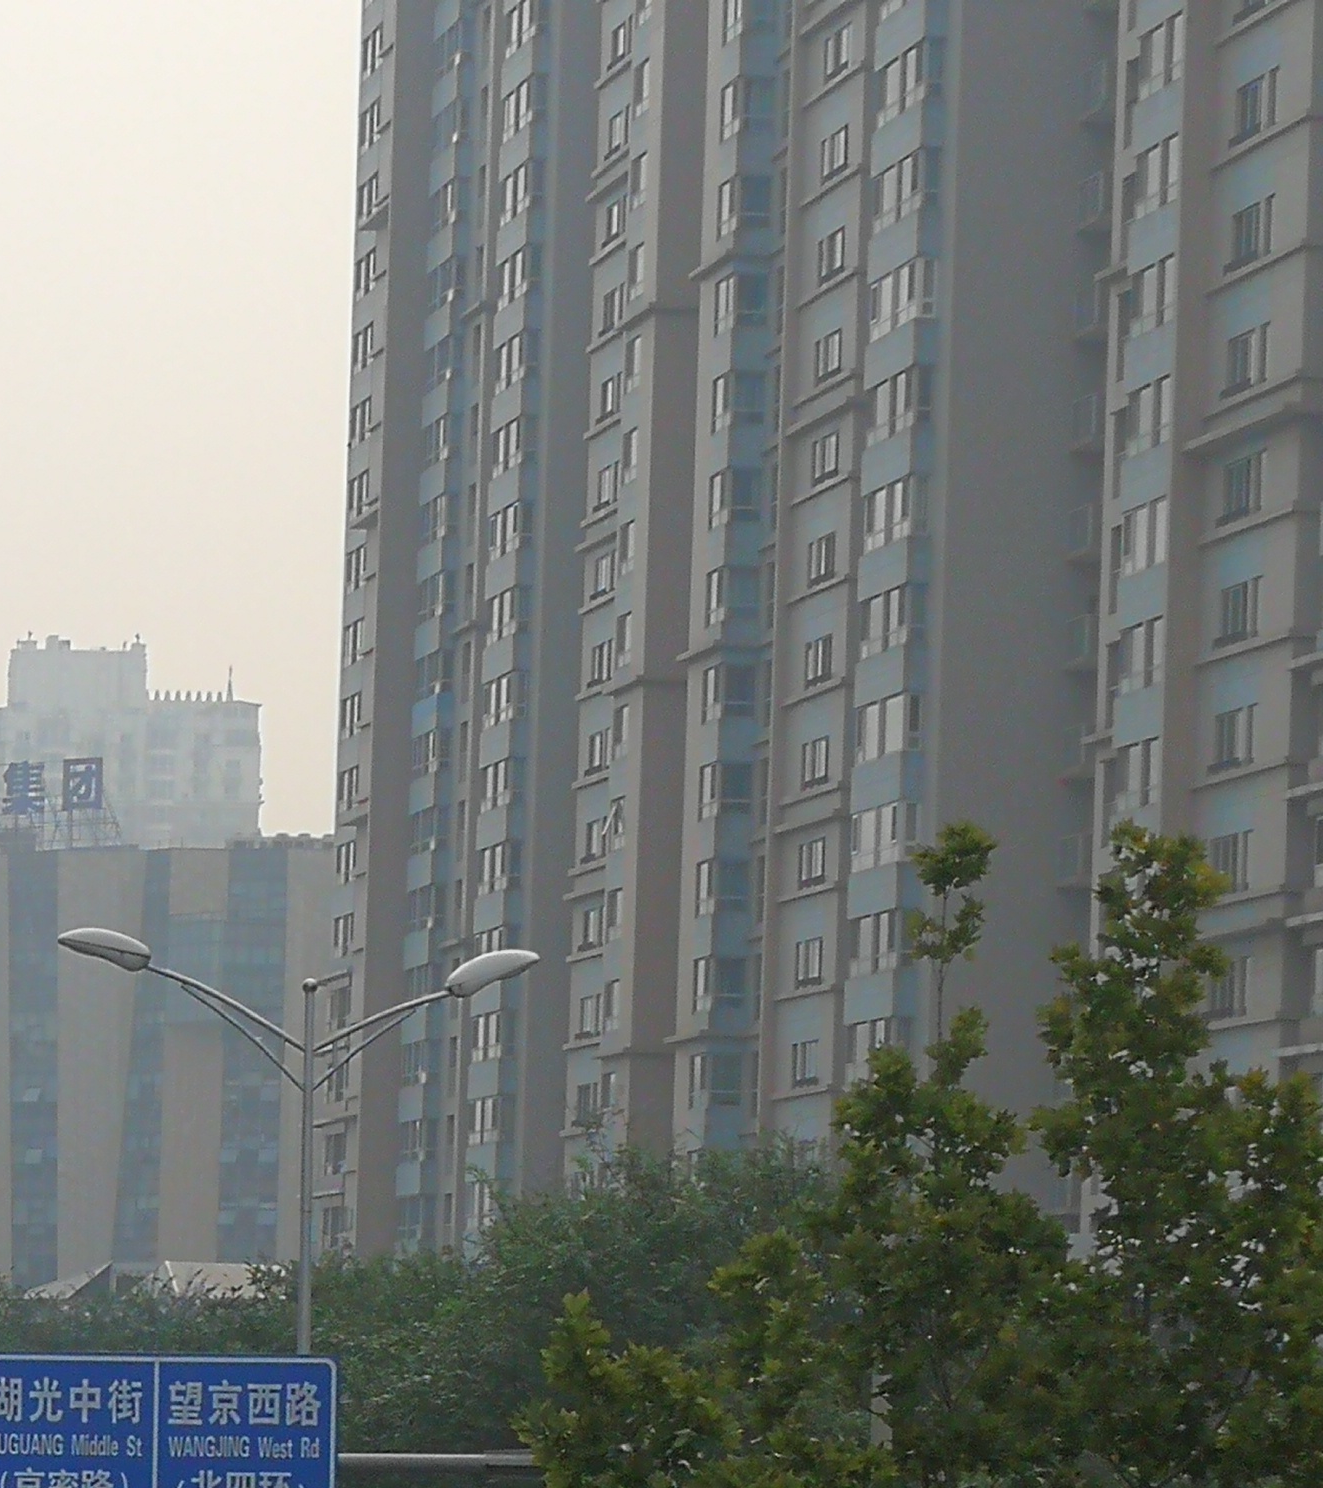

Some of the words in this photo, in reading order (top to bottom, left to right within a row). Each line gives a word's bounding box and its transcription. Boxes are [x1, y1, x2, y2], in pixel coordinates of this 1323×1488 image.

[168, 1379, 321, 1427] 望京西路
[71, 1435, 119, 1456] Middle
[126, 1435, 143, 1457] St
[168, 1435, 250, 1457] WANGJING
[257, 1436, 293, 1459] West
[301, 1437, 320, 1458] Rd
